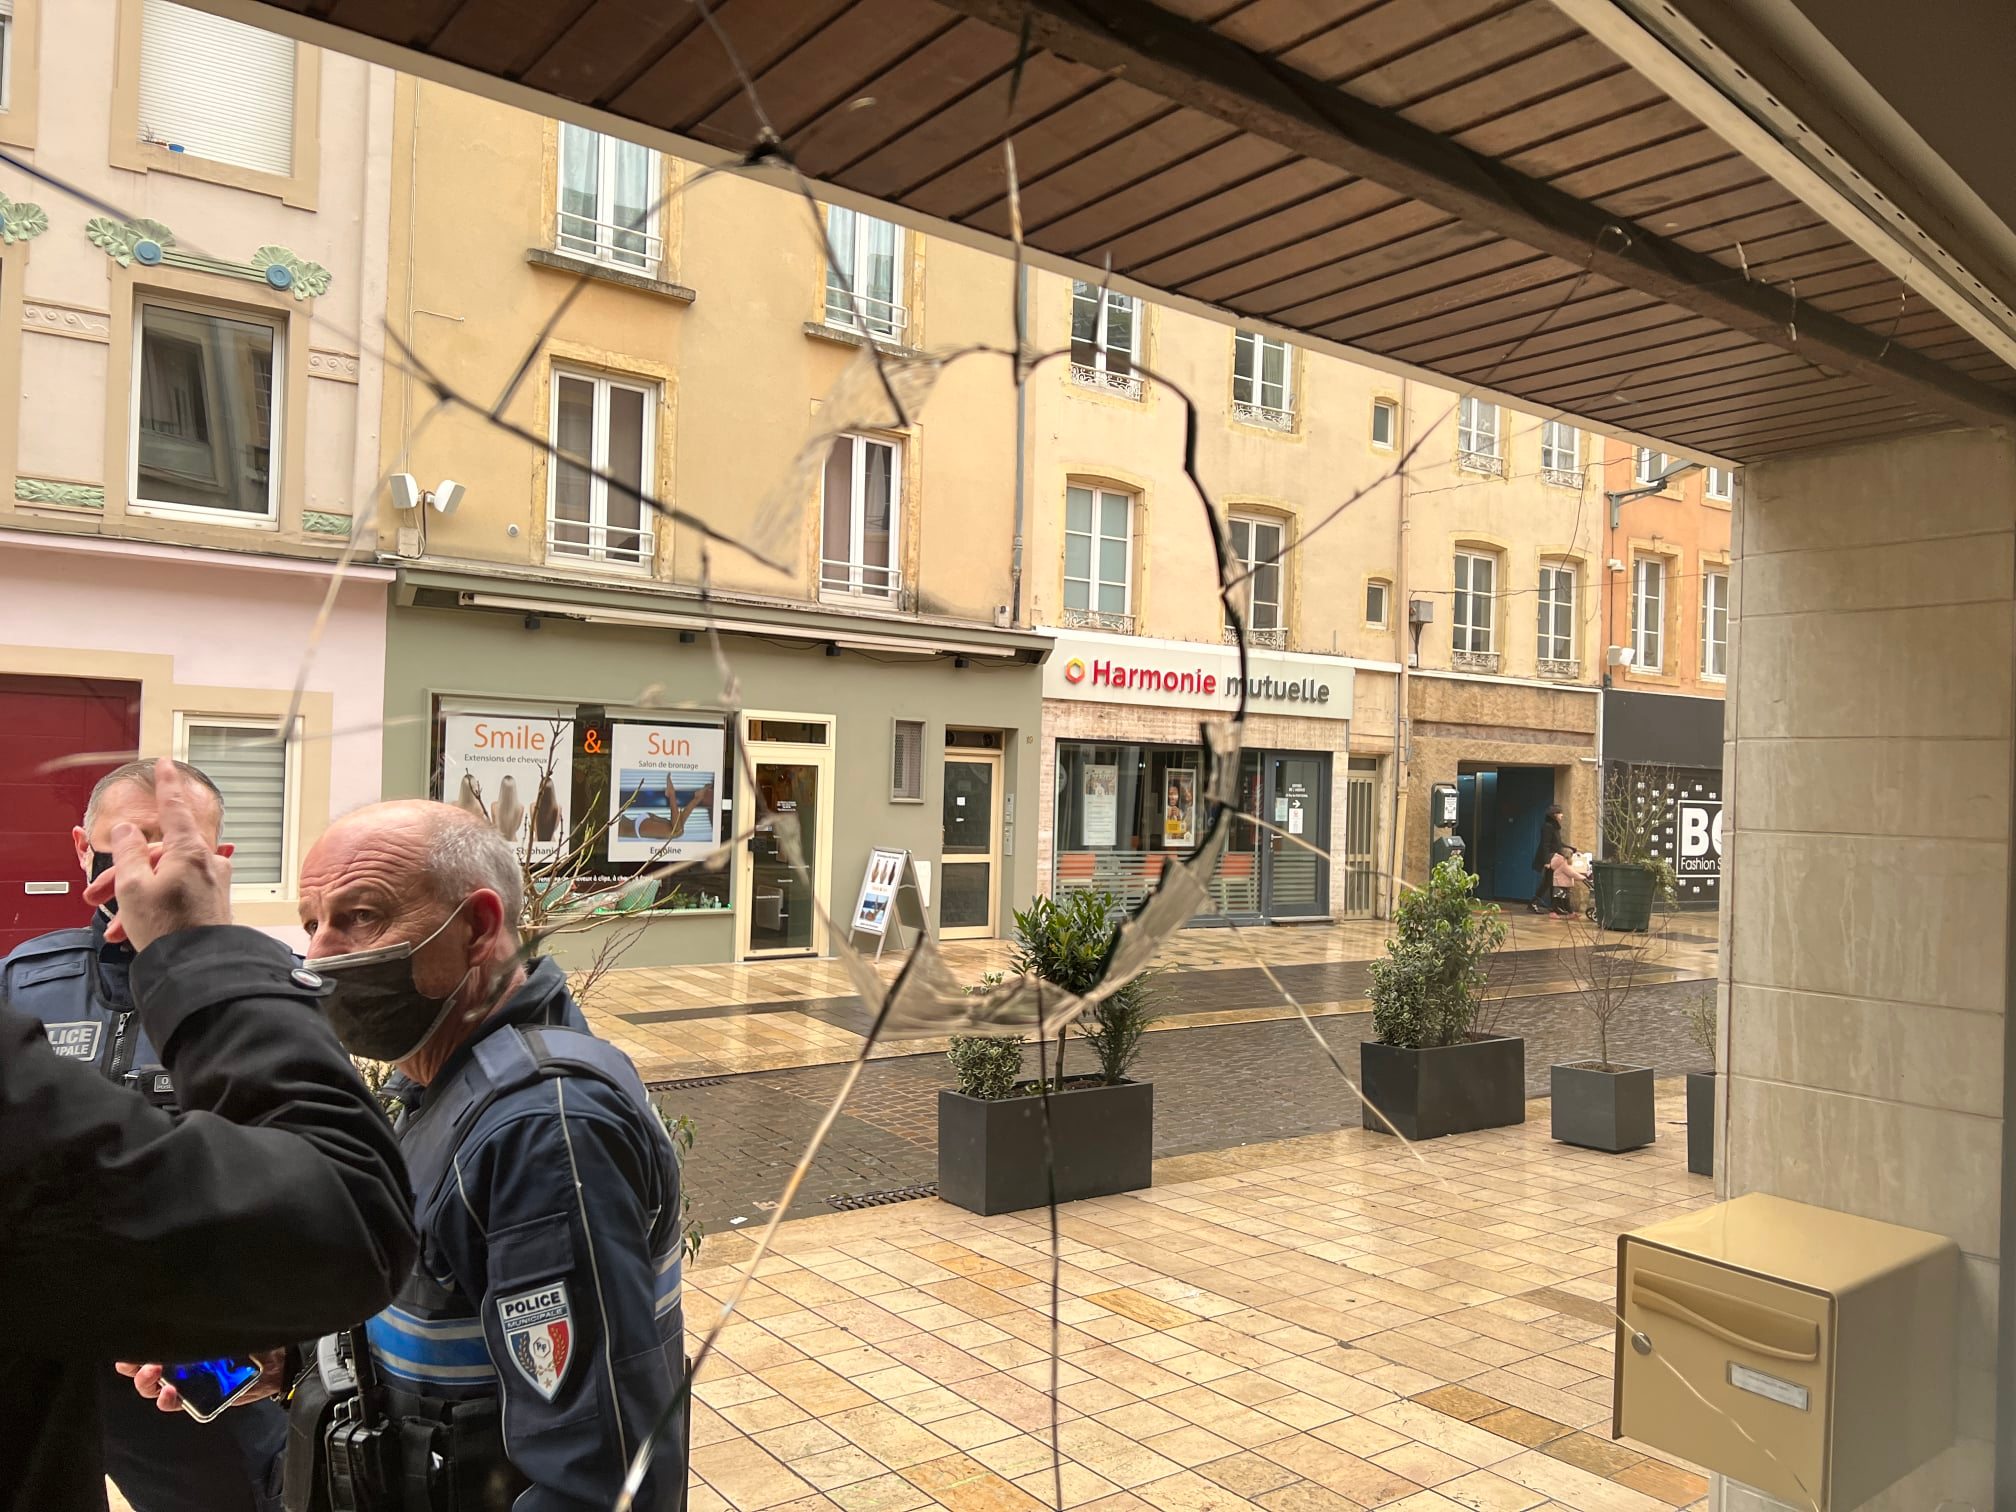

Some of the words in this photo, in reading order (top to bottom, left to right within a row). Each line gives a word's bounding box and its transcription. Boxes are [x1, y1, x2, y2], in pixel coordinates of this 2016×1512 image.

[1093, 659, 1217, 695] Harmonie
[1225, 675, 1330, 704] mutuelle
[474, 723, 545, 750] Smile
[584, 730, 601, 753] &
[647, 732, 690, 756] Sun
[464, 753, 505, 763] Extensions
[506, 755, 516, 763] de
[517, 756, 547, 764] cheveux
[638, 760, 657, 768] Salon
[668, 761, 698, 770] bronzage
[1680, 857, 1716, 871] Fashion
[53, 1044, 89, 1056] IPALE
[505, 1291, 561, 1317] POLICE
[507, 1308, 563, 1328] MUNICIPALE
